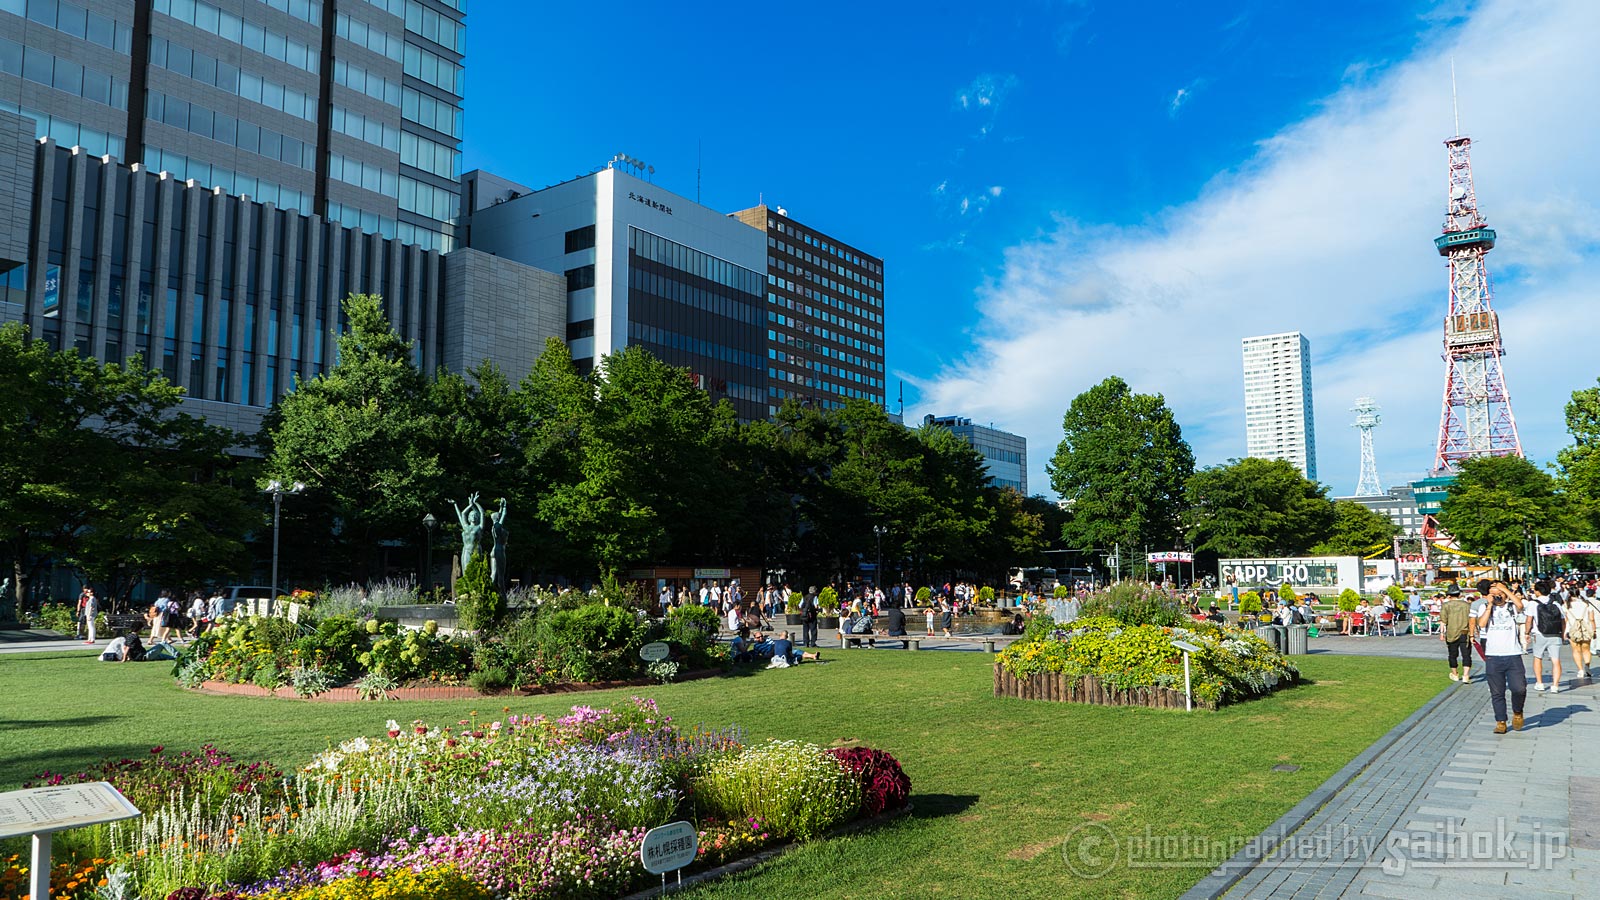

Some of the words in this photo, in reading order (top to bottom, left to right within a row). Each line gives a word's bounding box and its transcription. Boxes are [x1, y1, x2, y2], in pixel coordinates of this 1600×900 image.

[629, 192, 673, 216] 北海道新聞社
